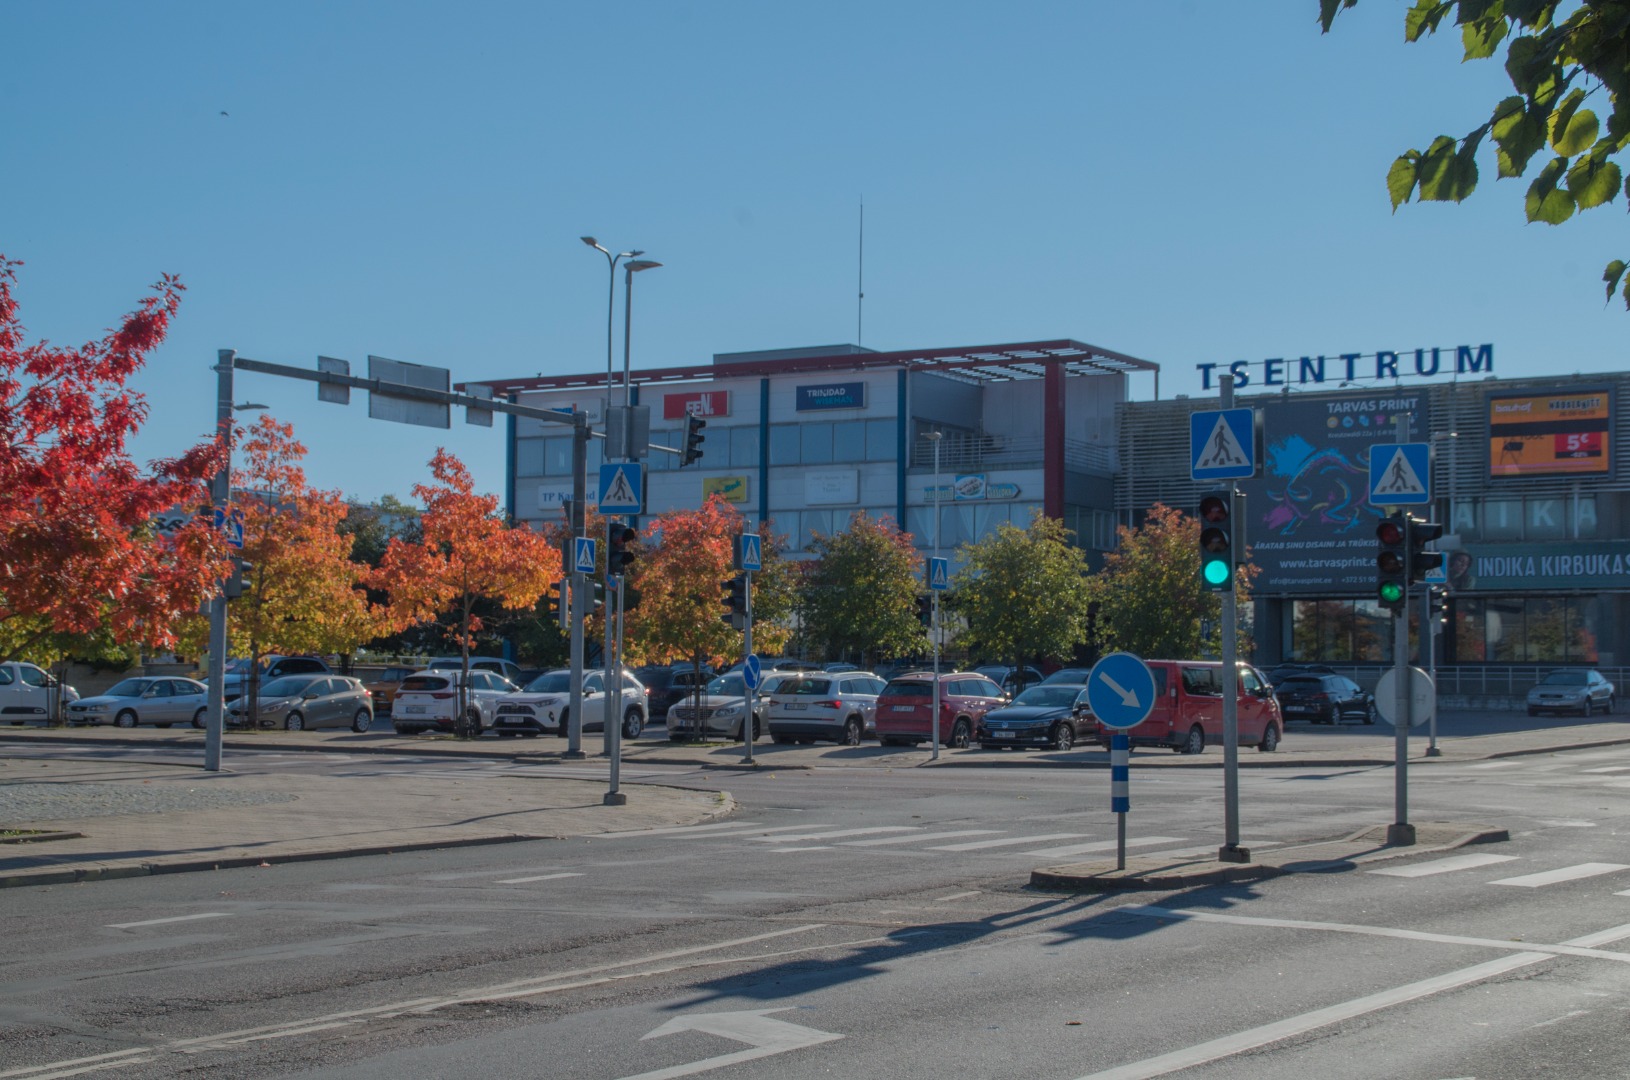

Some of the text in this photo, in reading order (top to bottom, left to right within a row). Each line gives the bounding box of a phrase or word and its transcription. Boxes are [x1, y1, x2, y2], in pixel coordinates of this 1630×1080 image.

[1196, 344, 1493, 390] TSENTRUM
[807, 388, 846, 397] TRINIDAD
[1327, 398, 1418, 413] TARVAS PRINT
[1495, 402, 1532, 412] bauhof
[543, 493, 555, 502] TP
[1254, 541, 1285, 550] ÄRATAB
[1286, 541, 1304, 549] SINU
[1305, 541, 1335, 549] DISAINI
[1336, 540, 1346, 548] JA
[1280, 557, 1377, 569] www.tarvasprint.e
[1478, 554, 1630, 577] INDIKA KIRBUKAS
[1269, 577, 1332, 586] info@tarvasprint.ee
[1341, 576, 1357, 584] +372
